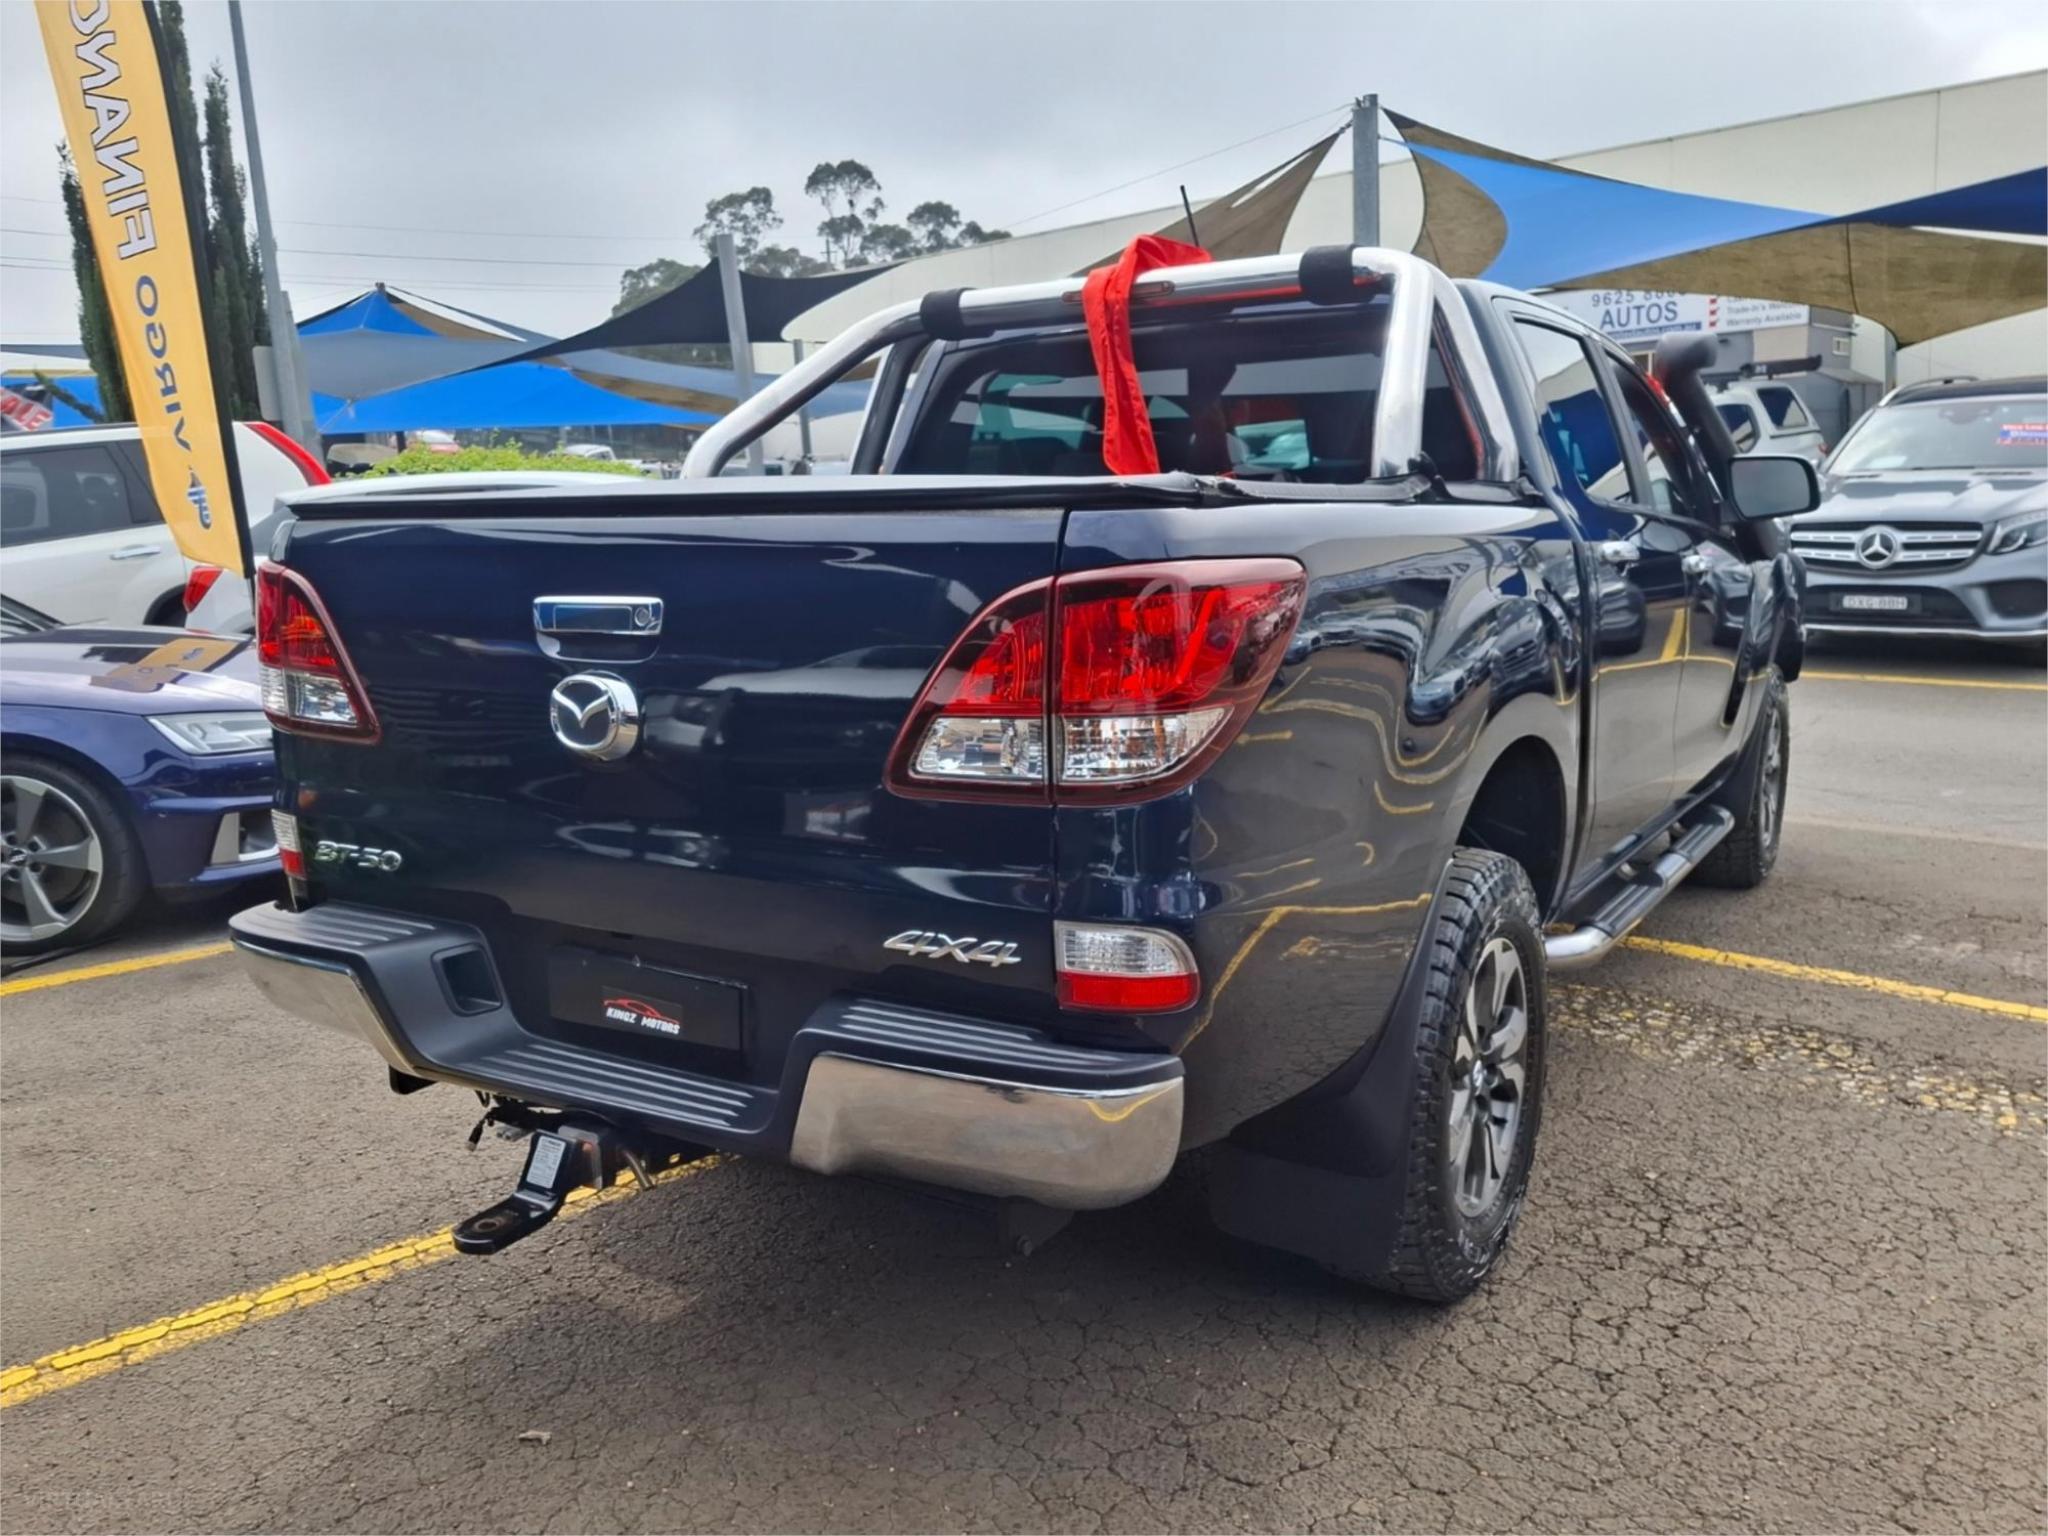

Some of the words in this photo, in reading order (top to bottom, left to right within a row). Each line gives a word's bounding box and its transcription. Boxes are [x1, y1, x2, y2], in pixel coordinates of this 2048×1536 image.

[1591, 290, 1635, 308] 9625
[1600, 301, 1679, 330] AUTOS
[0, 389, 52, 431] ALE
[314, 840, 403, 872] BT-50
[605, 1006, 638, 1024] KINGZ
[640, 1016, 681, 1035] MOTORS
